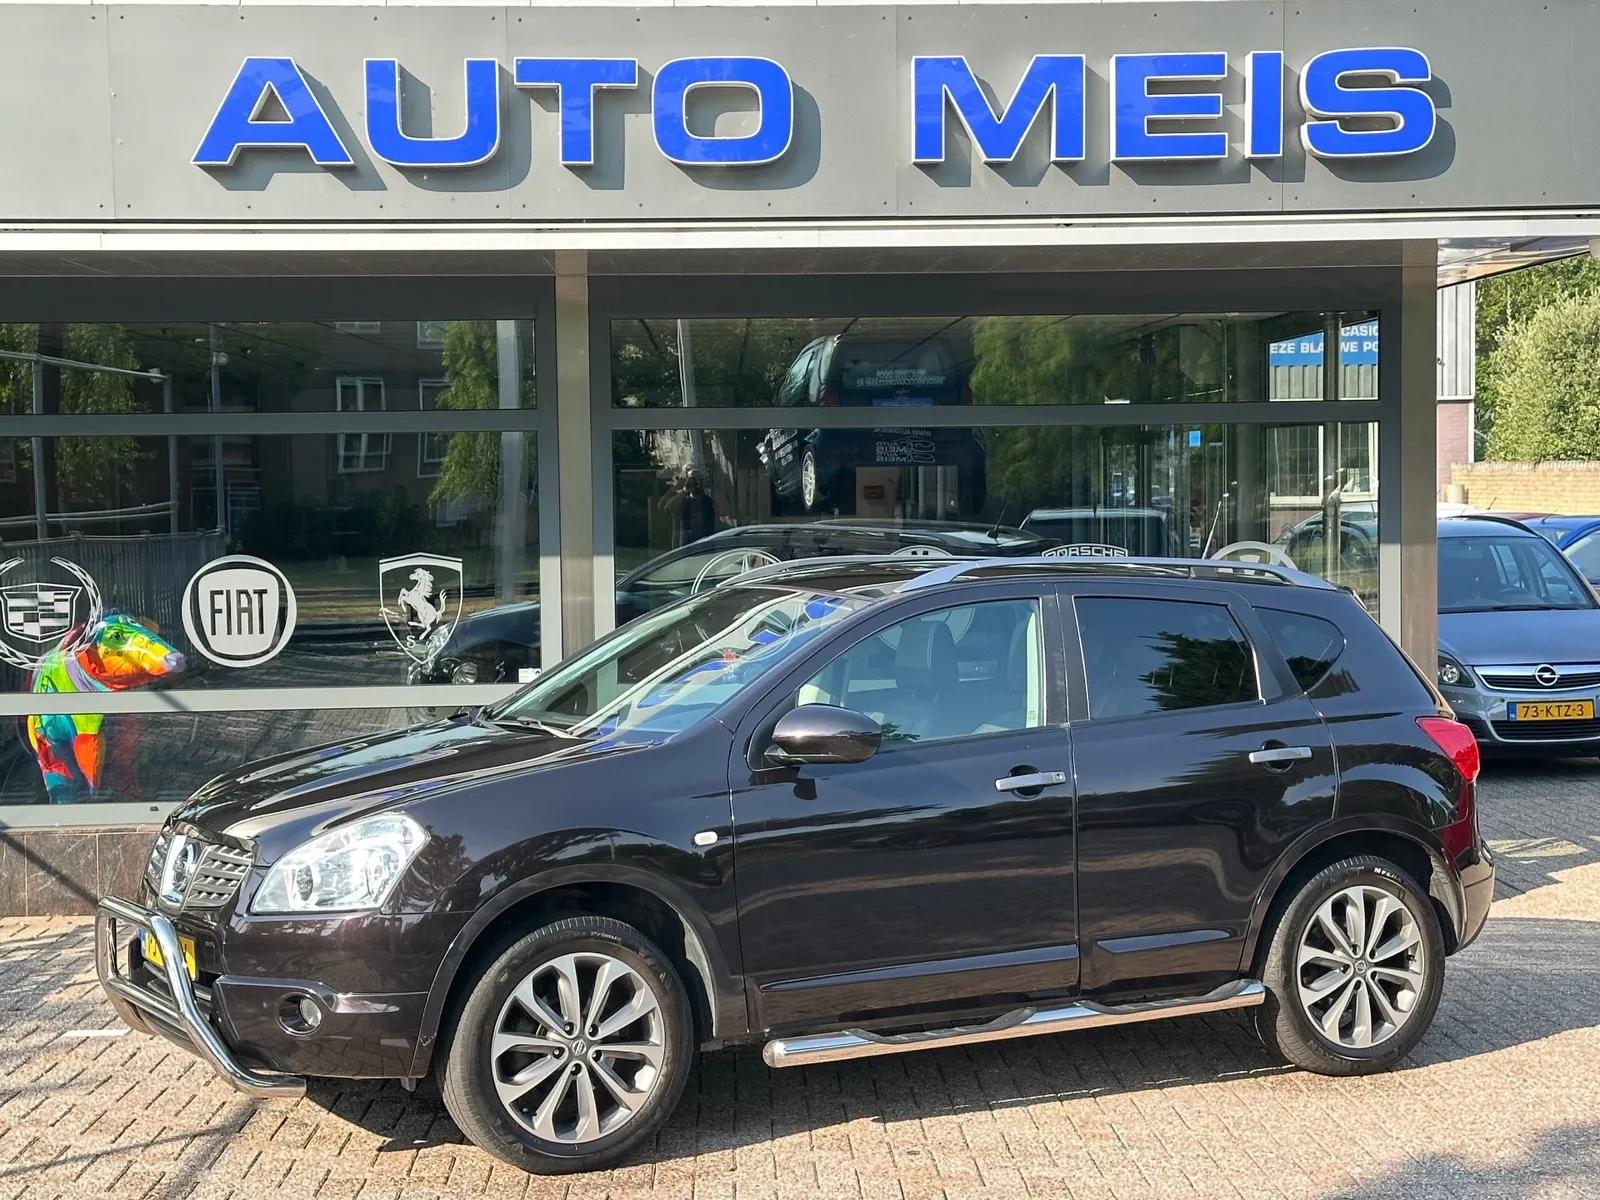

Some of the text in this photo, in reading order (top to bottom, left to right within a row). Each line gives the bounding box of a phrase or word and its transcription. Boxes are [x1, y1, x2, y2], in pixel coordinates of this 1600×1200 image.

[192, 46, 1437, 168] AUTO MEIS
[210, 589, 268, 636] FIAT
[1522, 704, 1584, 718] 73-KTZ-3
[590, 931, 622, 942] Primus
